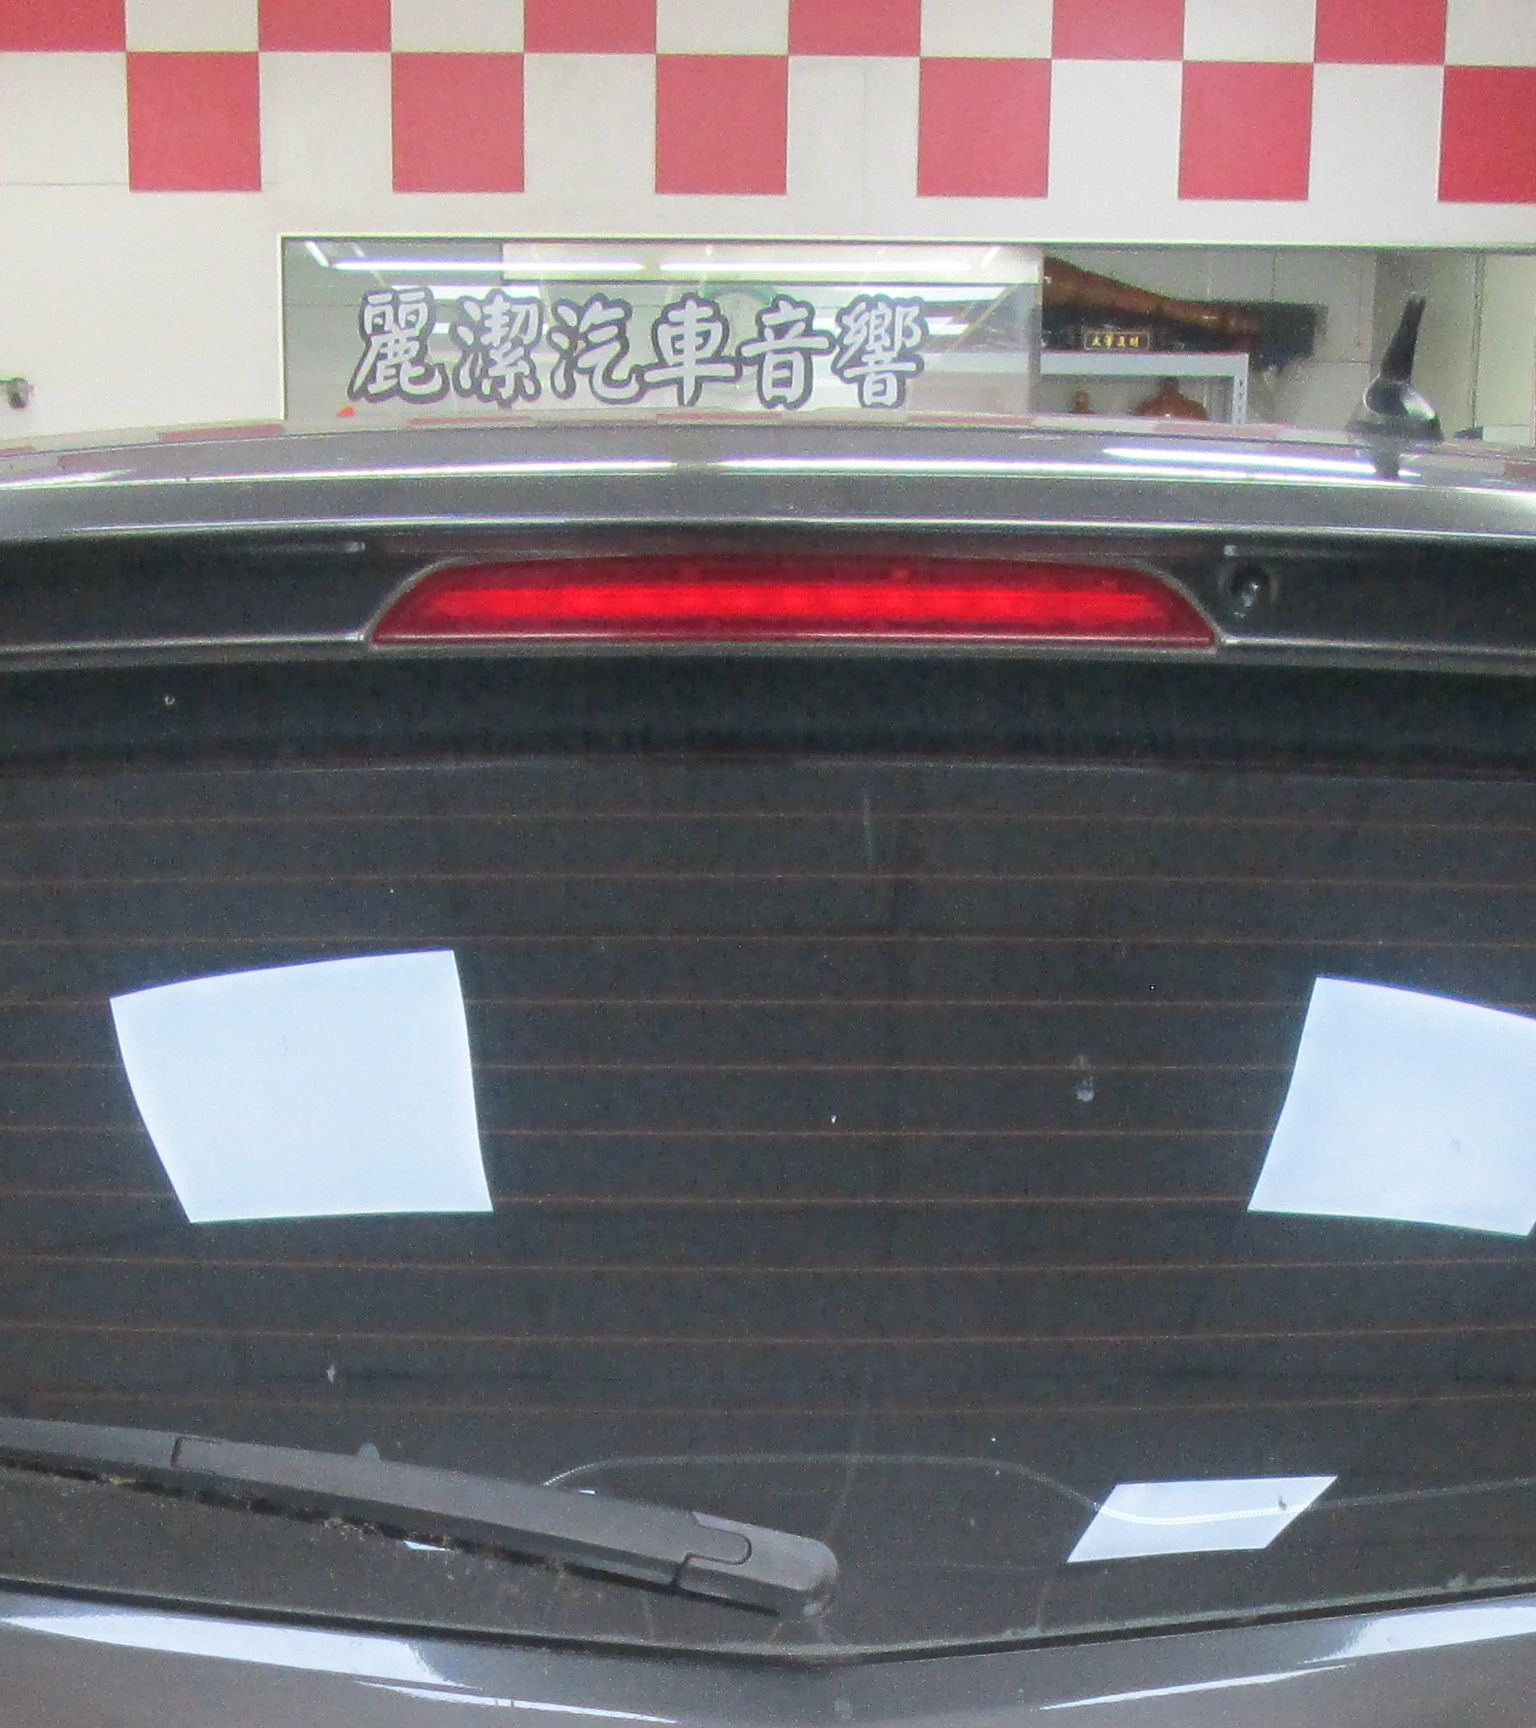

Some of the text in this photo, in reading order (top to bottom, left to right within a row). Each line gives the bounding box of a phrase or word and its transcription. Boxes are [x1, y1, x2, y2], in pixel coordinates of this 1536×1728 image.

[349, 288, 926, 408] 麗潔汽車音響
